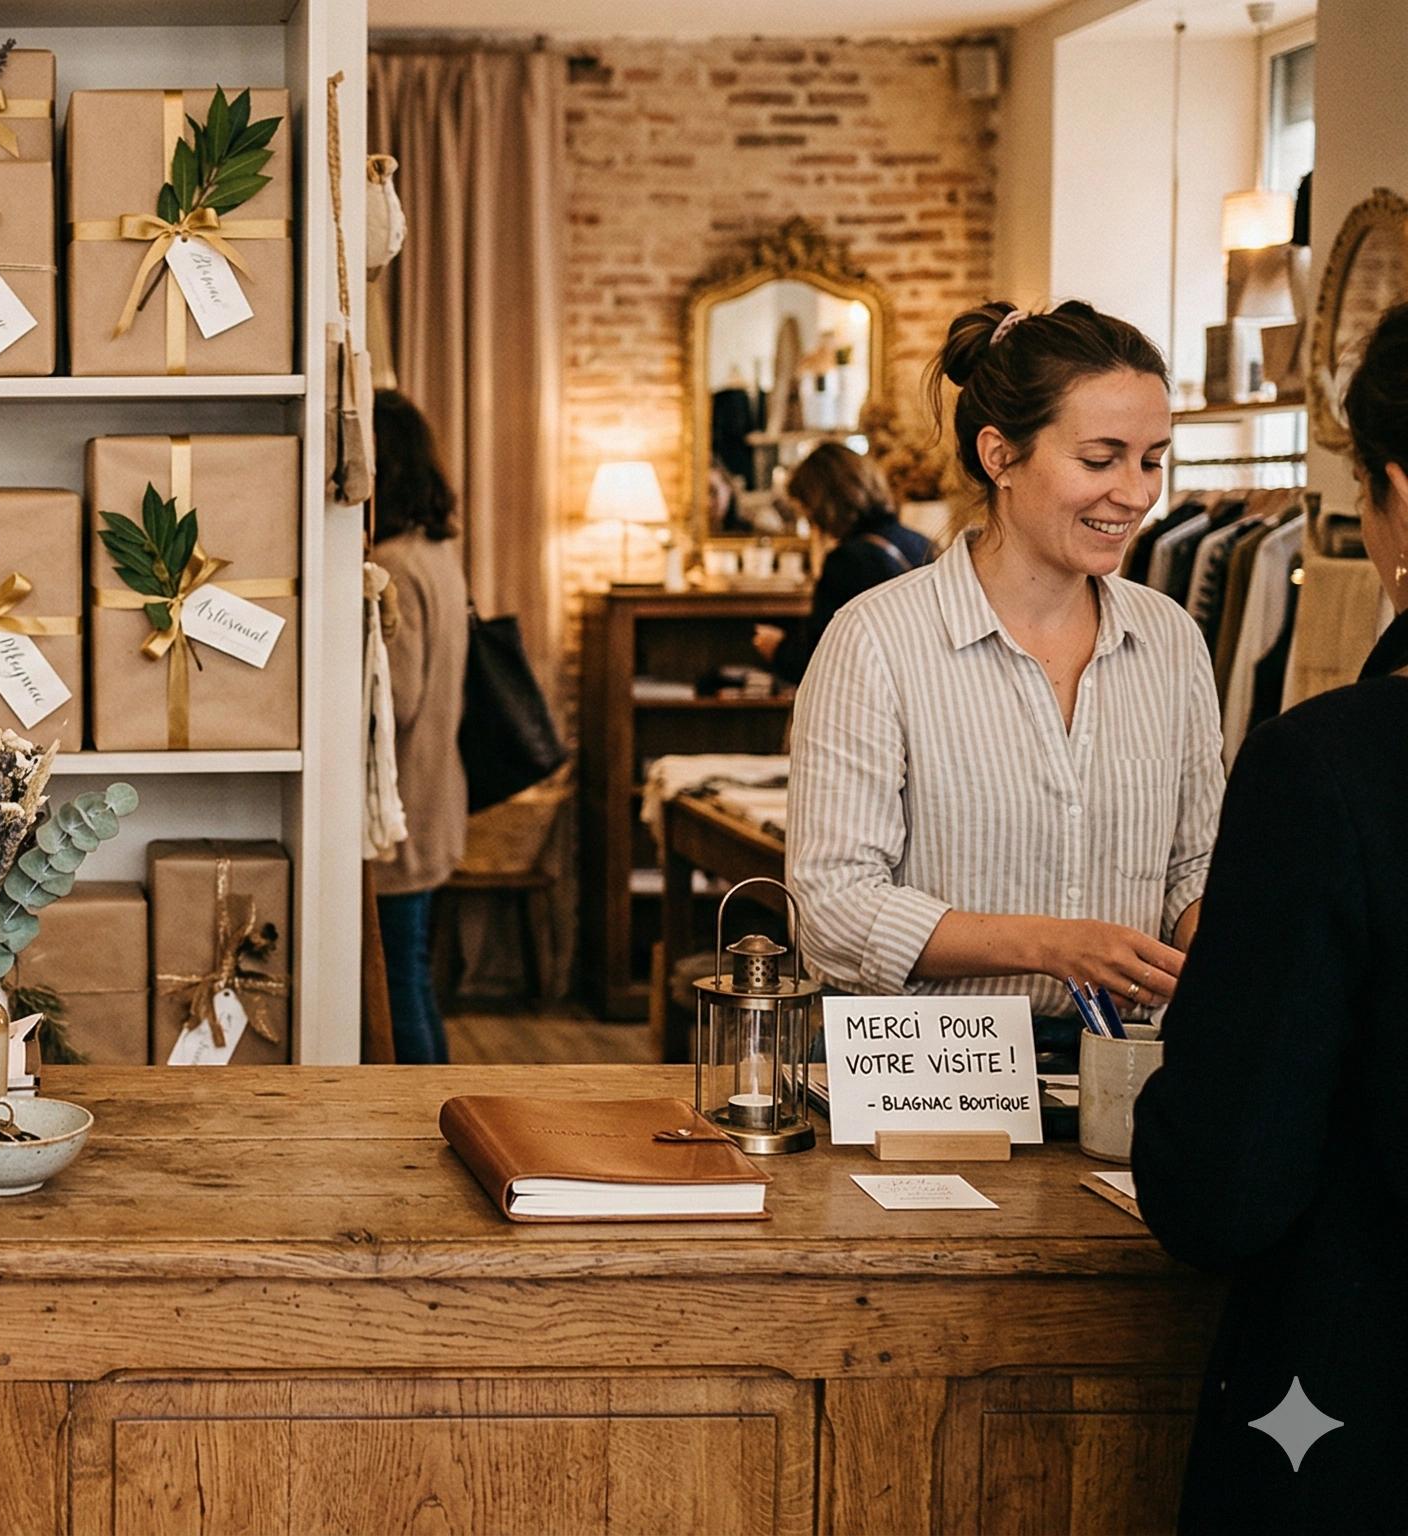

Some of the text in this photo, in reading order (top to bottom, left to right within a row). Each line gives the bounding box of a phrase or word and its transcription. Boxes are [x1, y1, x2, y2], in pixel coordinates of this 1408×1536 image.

[939, 1014, 998, 1039] POUR
[845, 1052, 915, 1075] VOTRE
[881, 1095, 953, 1112] BLAGNAC
